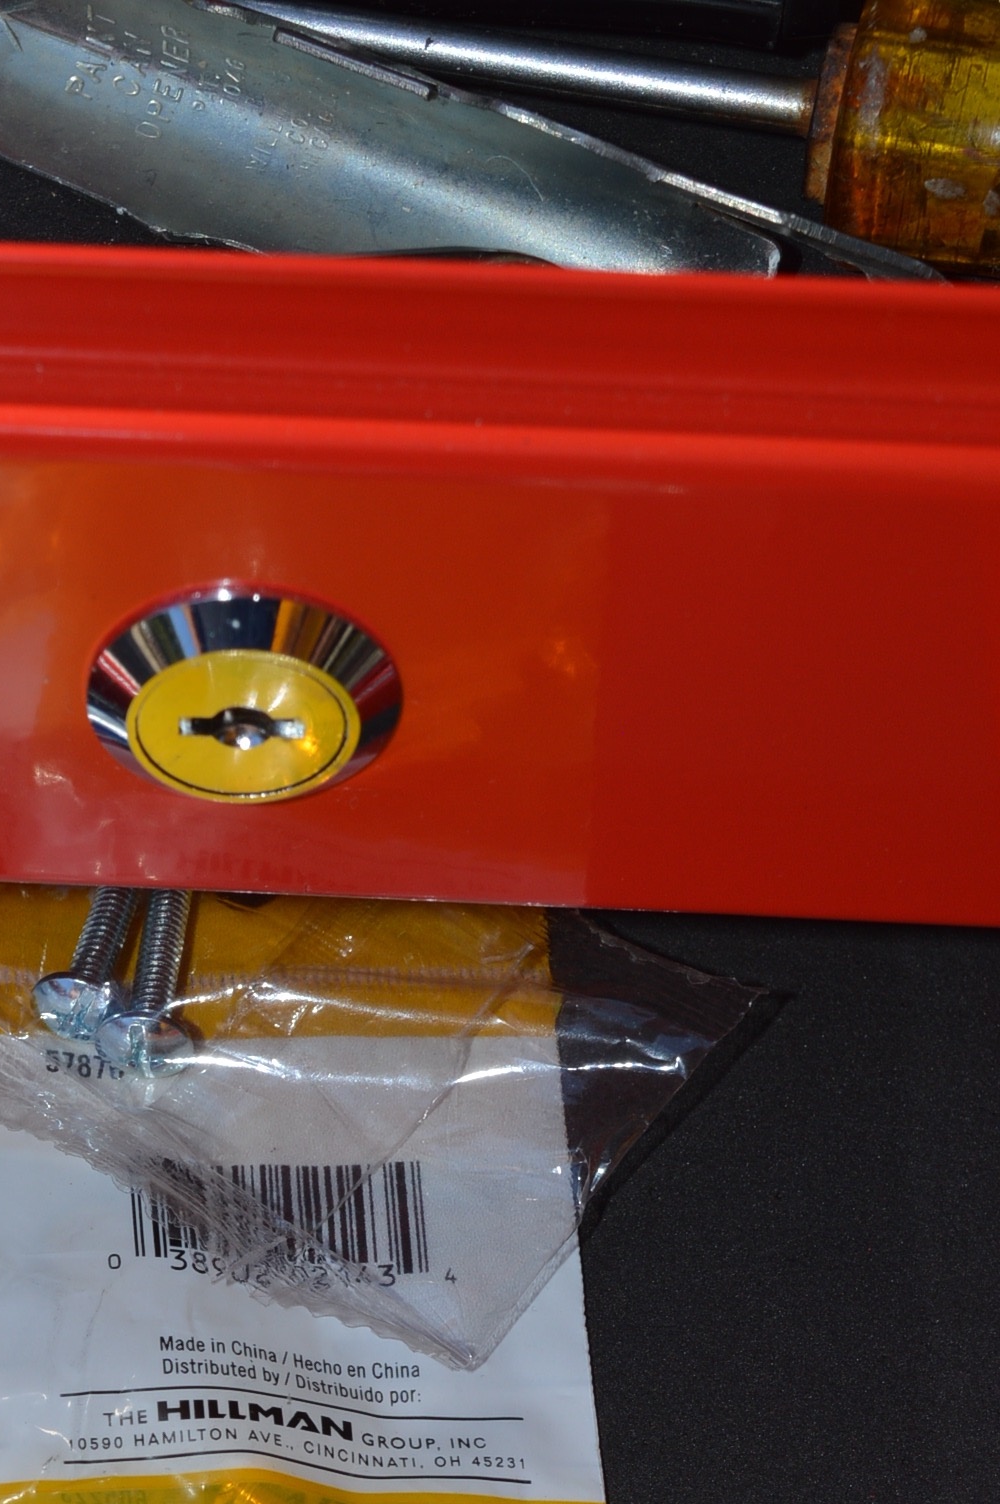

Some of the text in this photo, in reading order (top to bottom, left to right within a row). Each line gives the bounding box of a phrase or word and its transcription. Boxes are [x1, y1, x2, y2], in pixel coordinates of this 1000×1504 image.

[64, 3, 116, 100] PAINT
[111, 30, 152, 97] CAN
[134, 23, 191, 139] OPENER
[107, 1253, 122, 1270] 0
[444, 1268, 457, 1284] 4
[159, 1336, 420, 1378] Made in China / Hecho en China
[162, 1358, 421, 1407] Distributed by / Distribuido por:
[70, 1435, 124, 1451] 10590
[133, 1426, 238, 1448] HAMILTON
[434, 1455, 461, 1468] OH
[471, 1456, 526, 1470] 45231
[103, 1409, 148, 1427] THE
[157, 1400, 354, 1441] HILLMAN
[450, 1436, 487, 1450] INC
